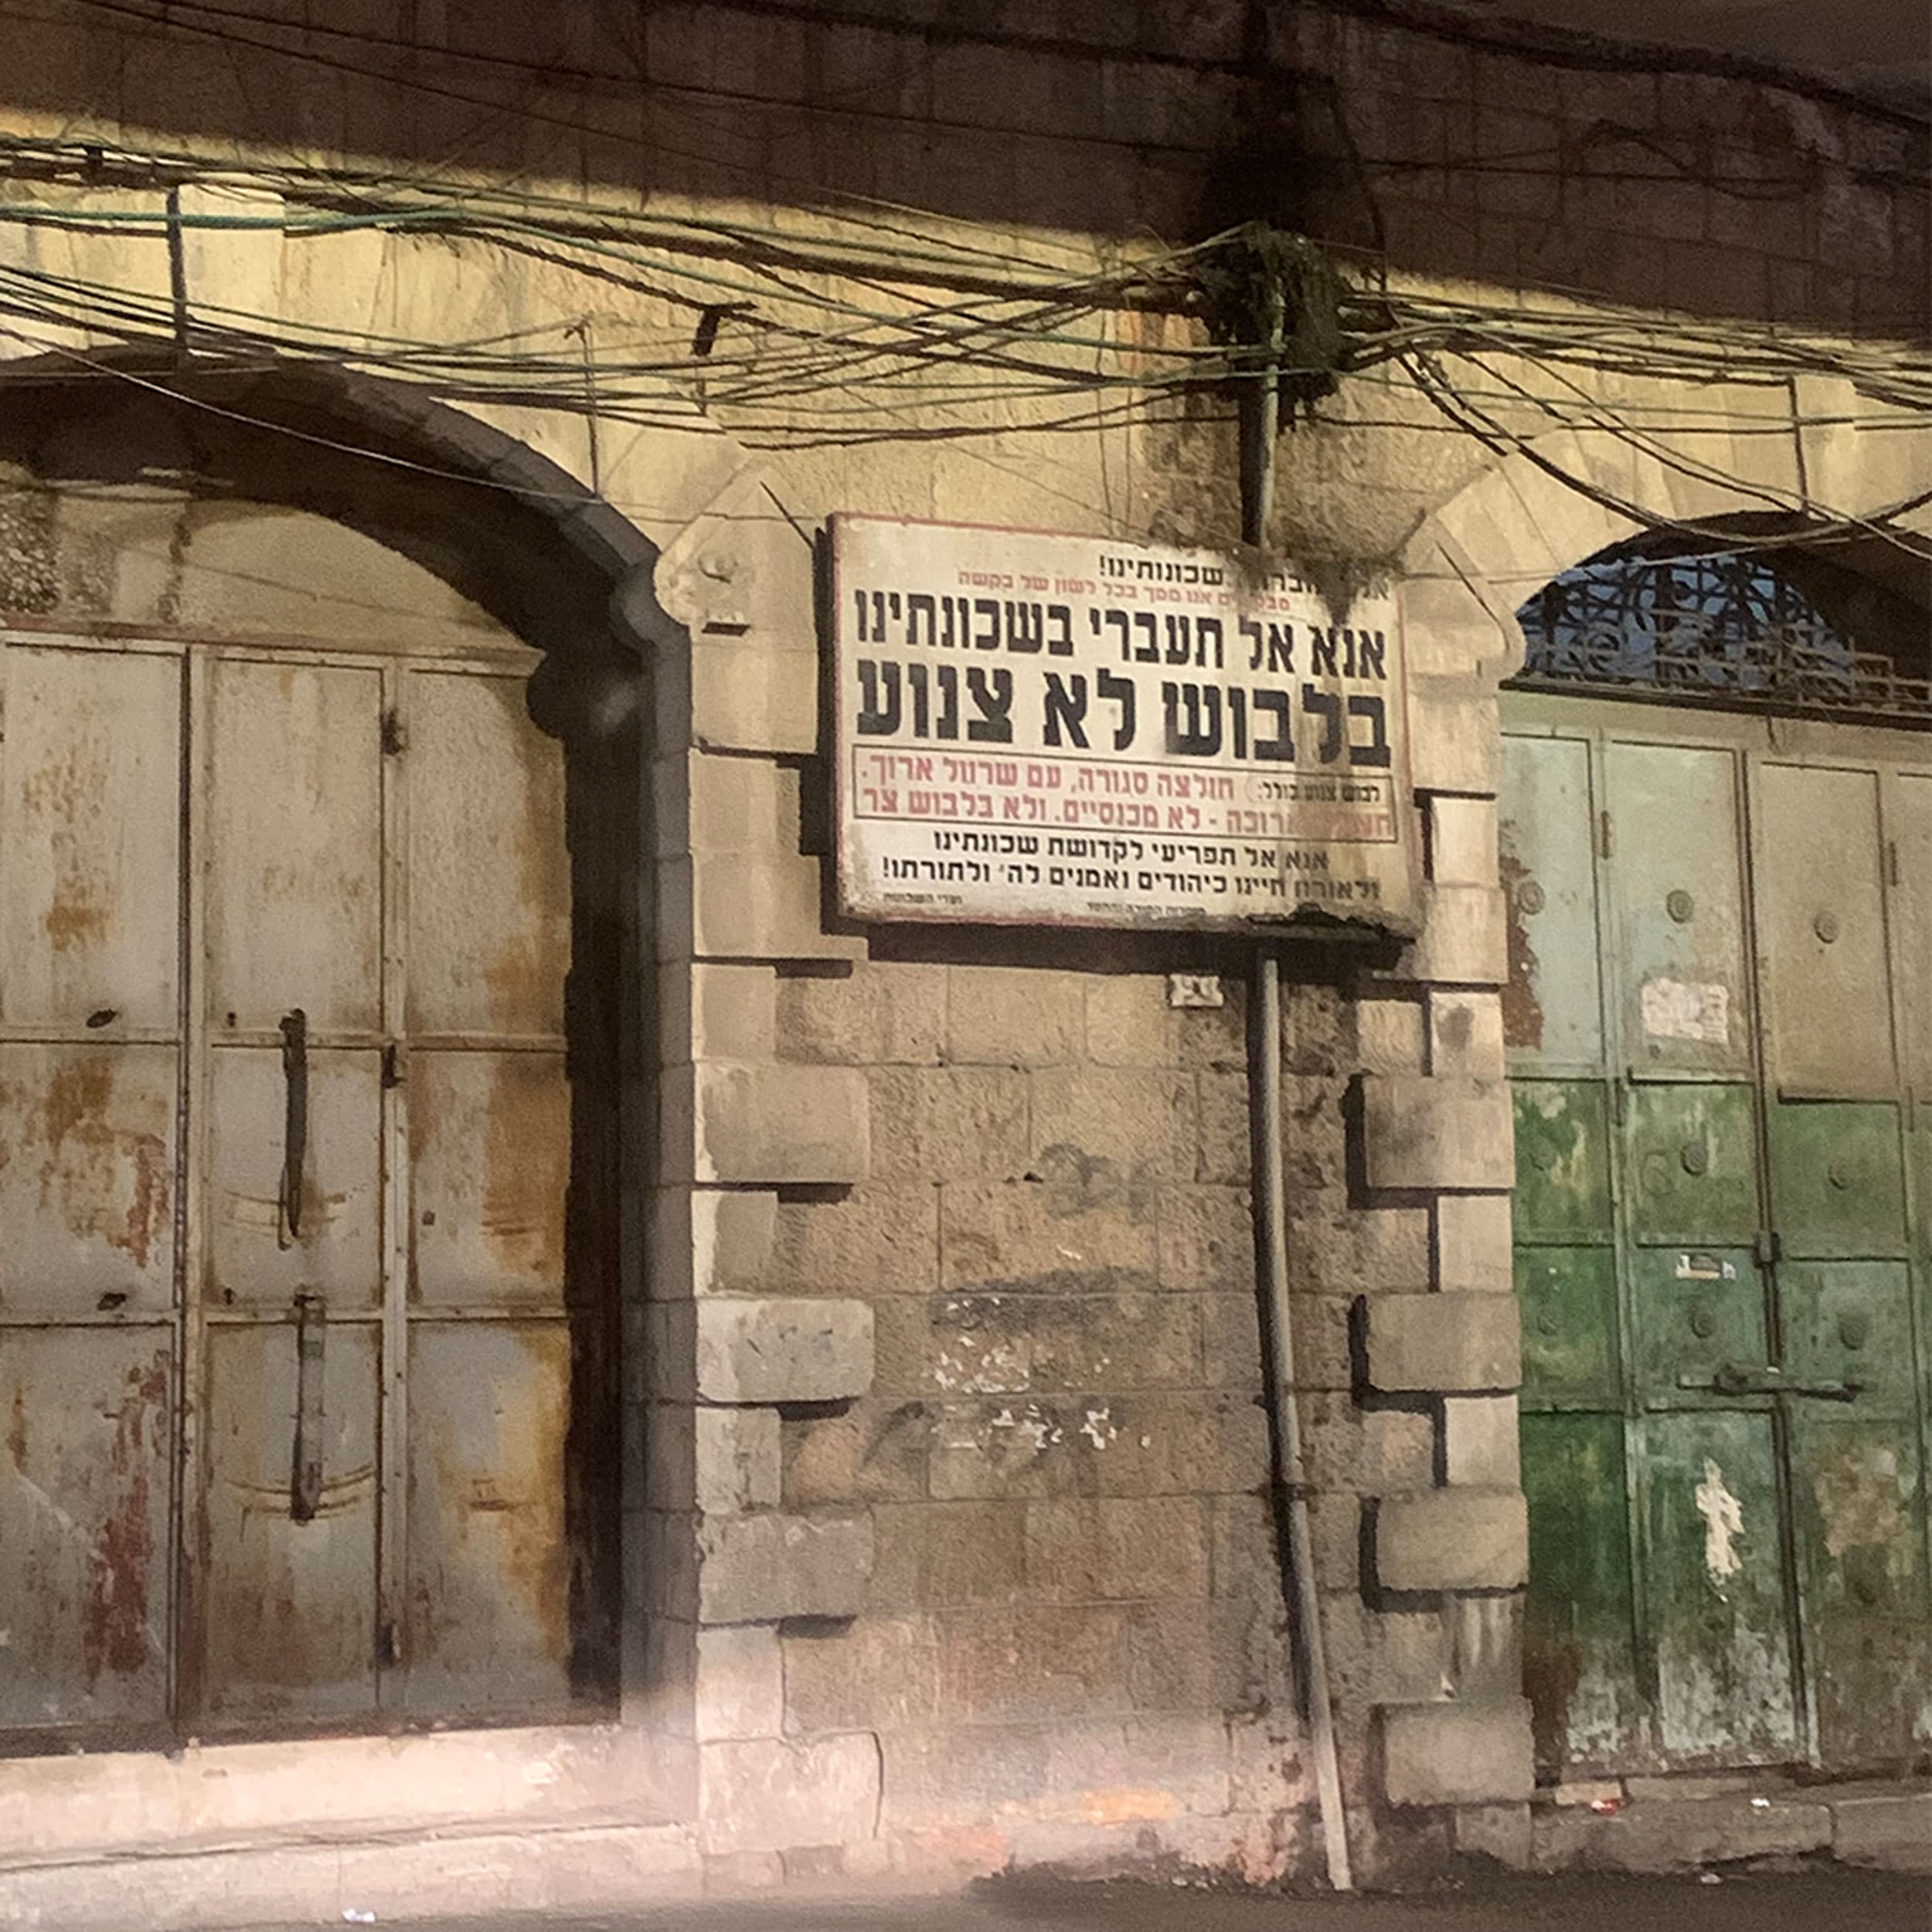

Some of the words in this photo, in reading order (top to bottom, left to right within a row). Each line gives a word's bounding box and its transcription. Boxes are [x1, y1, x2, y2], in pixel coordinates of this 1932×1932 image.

[958, 571, 1013, 590] בקשה
[1020, 574, 1049, 591] של
[1099, 555, 1238, 586] שכונותינו!
[1055, 577, 1096, 596] לשון
[1103, 582, 1137, 598] בכל
[1187, 590, 1212, 605] אנו
[855, 590, 1073, 656] בשכונתינו
[1089, 607, 1223, 669] תעברי
[1239, 615, 1295, 674] אל
[1307, 625, 1387, 680] אנא
[857, 659, 1013, 743] צנוע
[1043, 668, 1136, 751] לא
[1162, 682, 1391, 768] בלבוש
[943, 757, 1017, 787] שרוול
[1027, 764, 1062, 788] עם
[863, 787, 898, 812] צר
[1157, 773, 1234, 800] חולצה
[908, 791, 994, 818] בלבוש
[1004, 794, 1046, 820] ולא
[1168, 804, 1200, 830] לא
[934, 832, 1039, 855] שכונתינו
[1048, 837, 1144, 865] לקדושת
[1151, 842, 1236, 866] תפריעי
[1243, 846, 1276, 867] אל
[883, 856, 991, 883] ולתורתו!
[1285, 849, 1330, 869] אנא
[1049, 866, 1129, 889] ואמנים
[1138, 870, 1227, 893] כיהודים
[1234, 876, 1286, 897] חיינו
